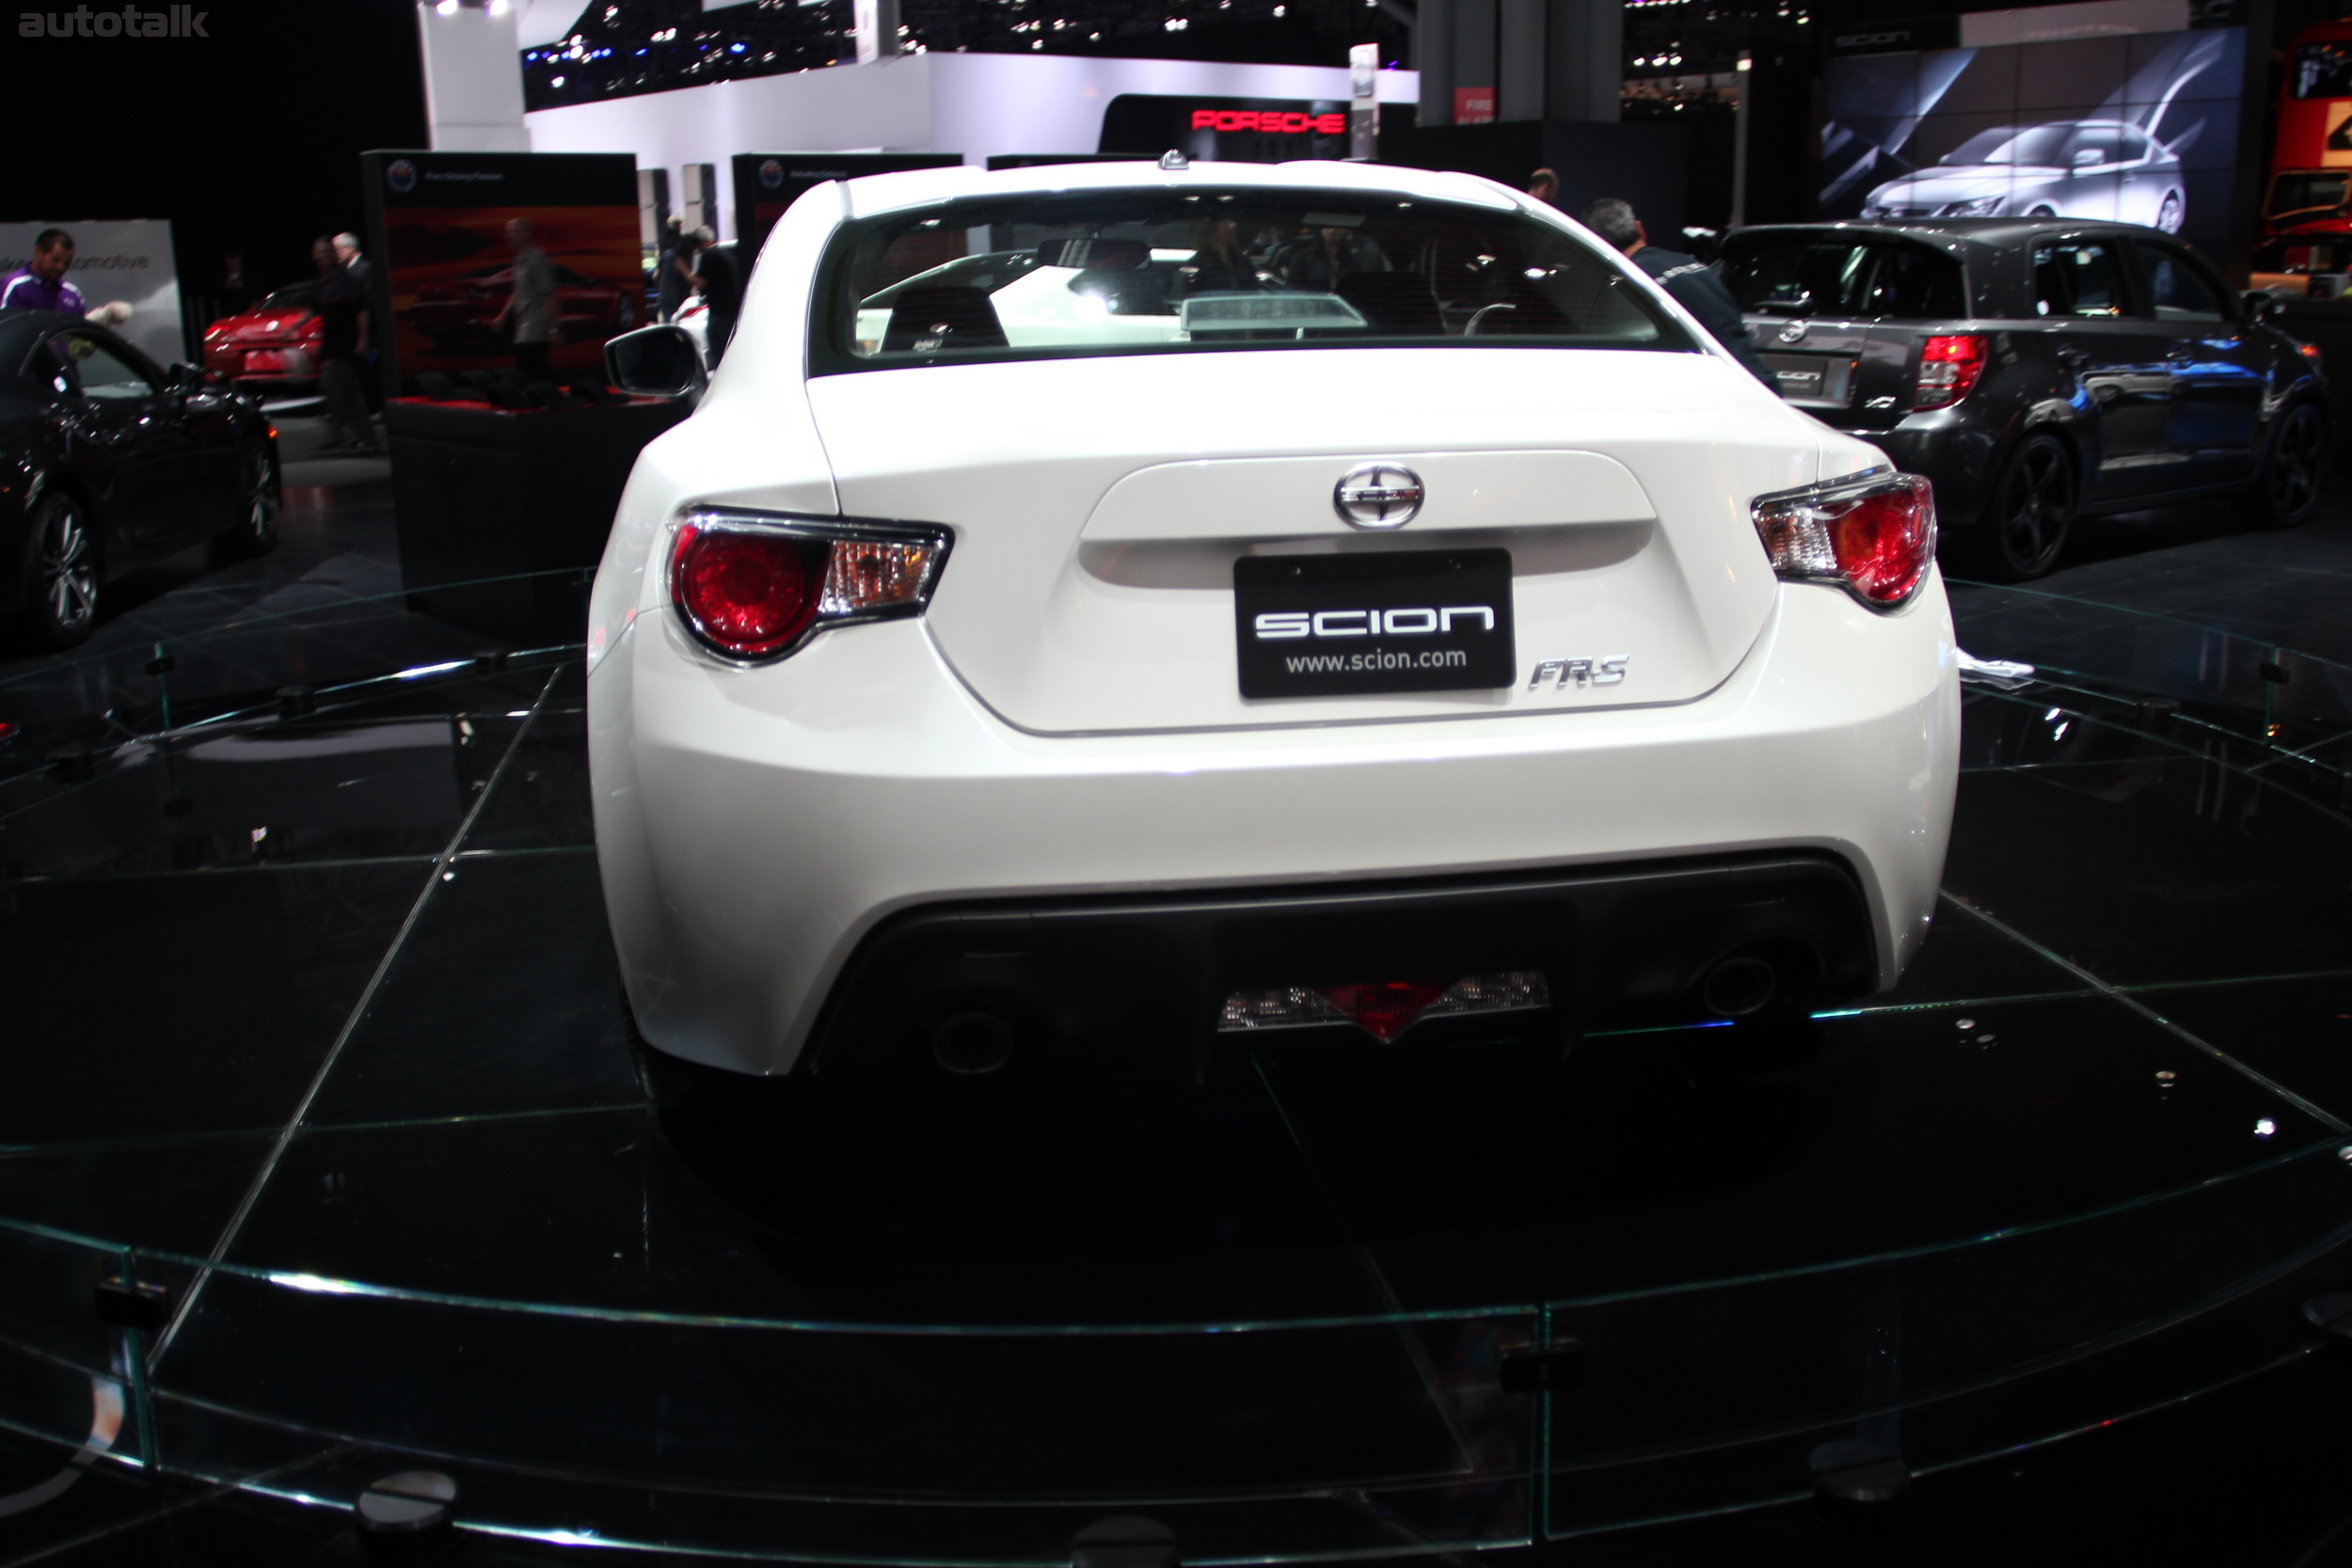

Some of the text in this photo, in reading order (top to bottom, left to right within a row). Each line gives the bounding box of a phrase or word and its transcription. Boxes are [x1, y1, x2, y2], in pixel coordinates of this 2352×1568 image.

[1834, 29, 1912, 49] SCION
[1465, 99, 1496, 111] FIRE
[1191, 109, 1346, 134] PORSCHE
[1255, 605, 1495, 639] SCION
[1285, 647, 1468, 673] www.scion.com
[1527, 653, 1631, 690] FR-S
